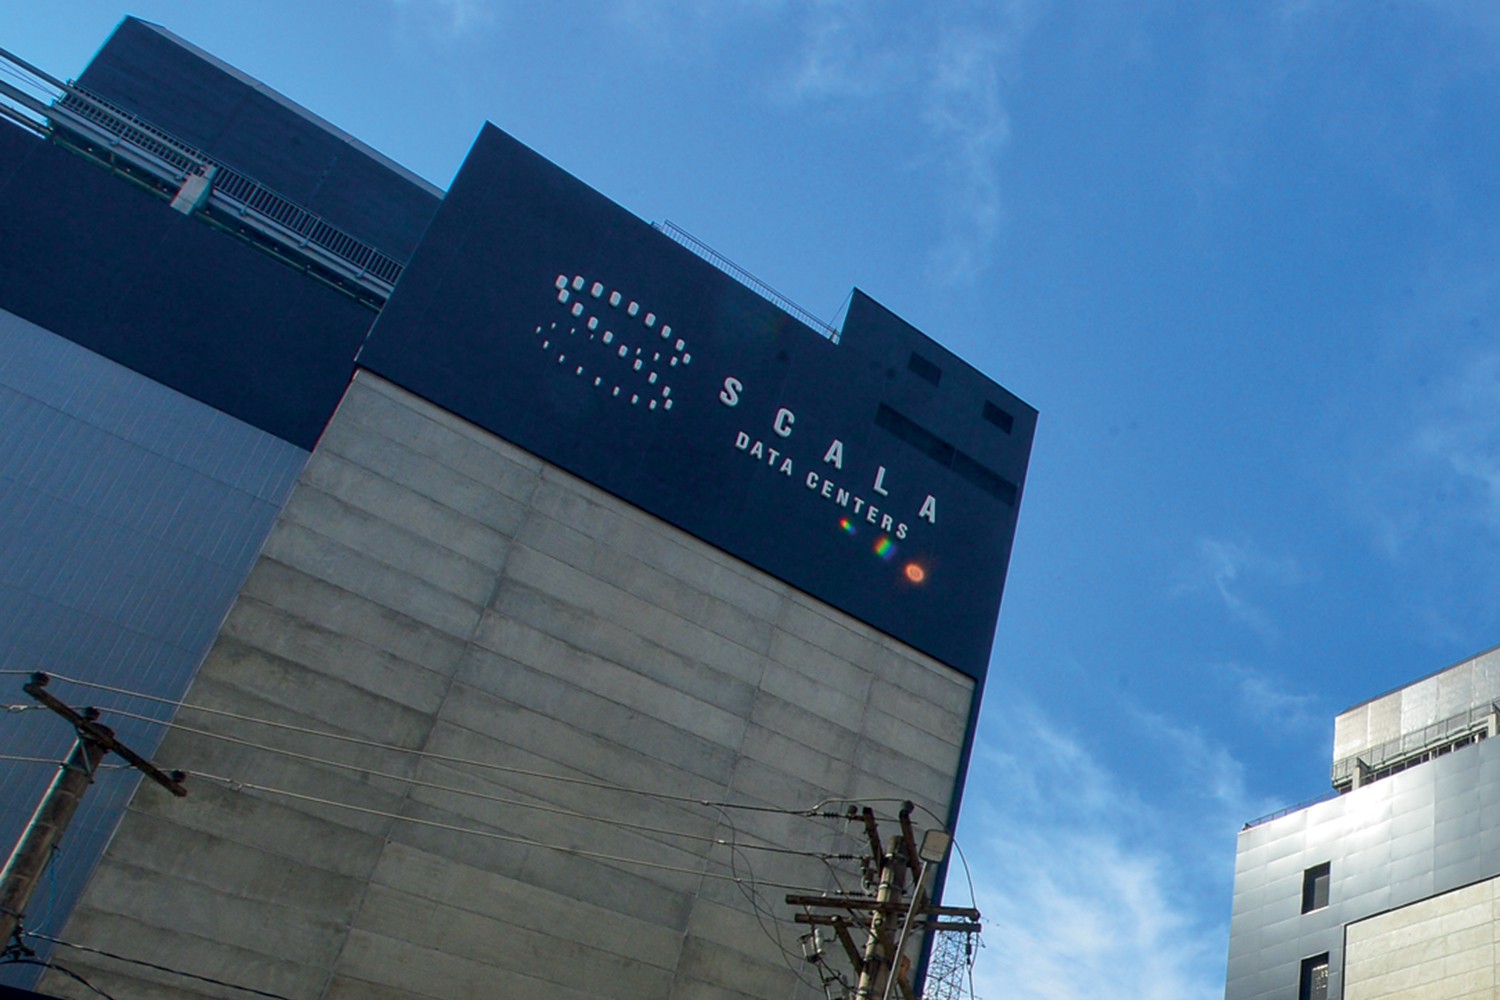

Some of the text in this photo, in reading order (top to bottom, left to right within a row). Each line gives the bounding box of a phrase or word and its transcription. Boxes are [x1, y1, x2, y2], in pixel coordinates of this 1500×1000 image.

[719, 377, 938, 524] SCALA
[735, 431, 909, 541] DATA CENTERS
